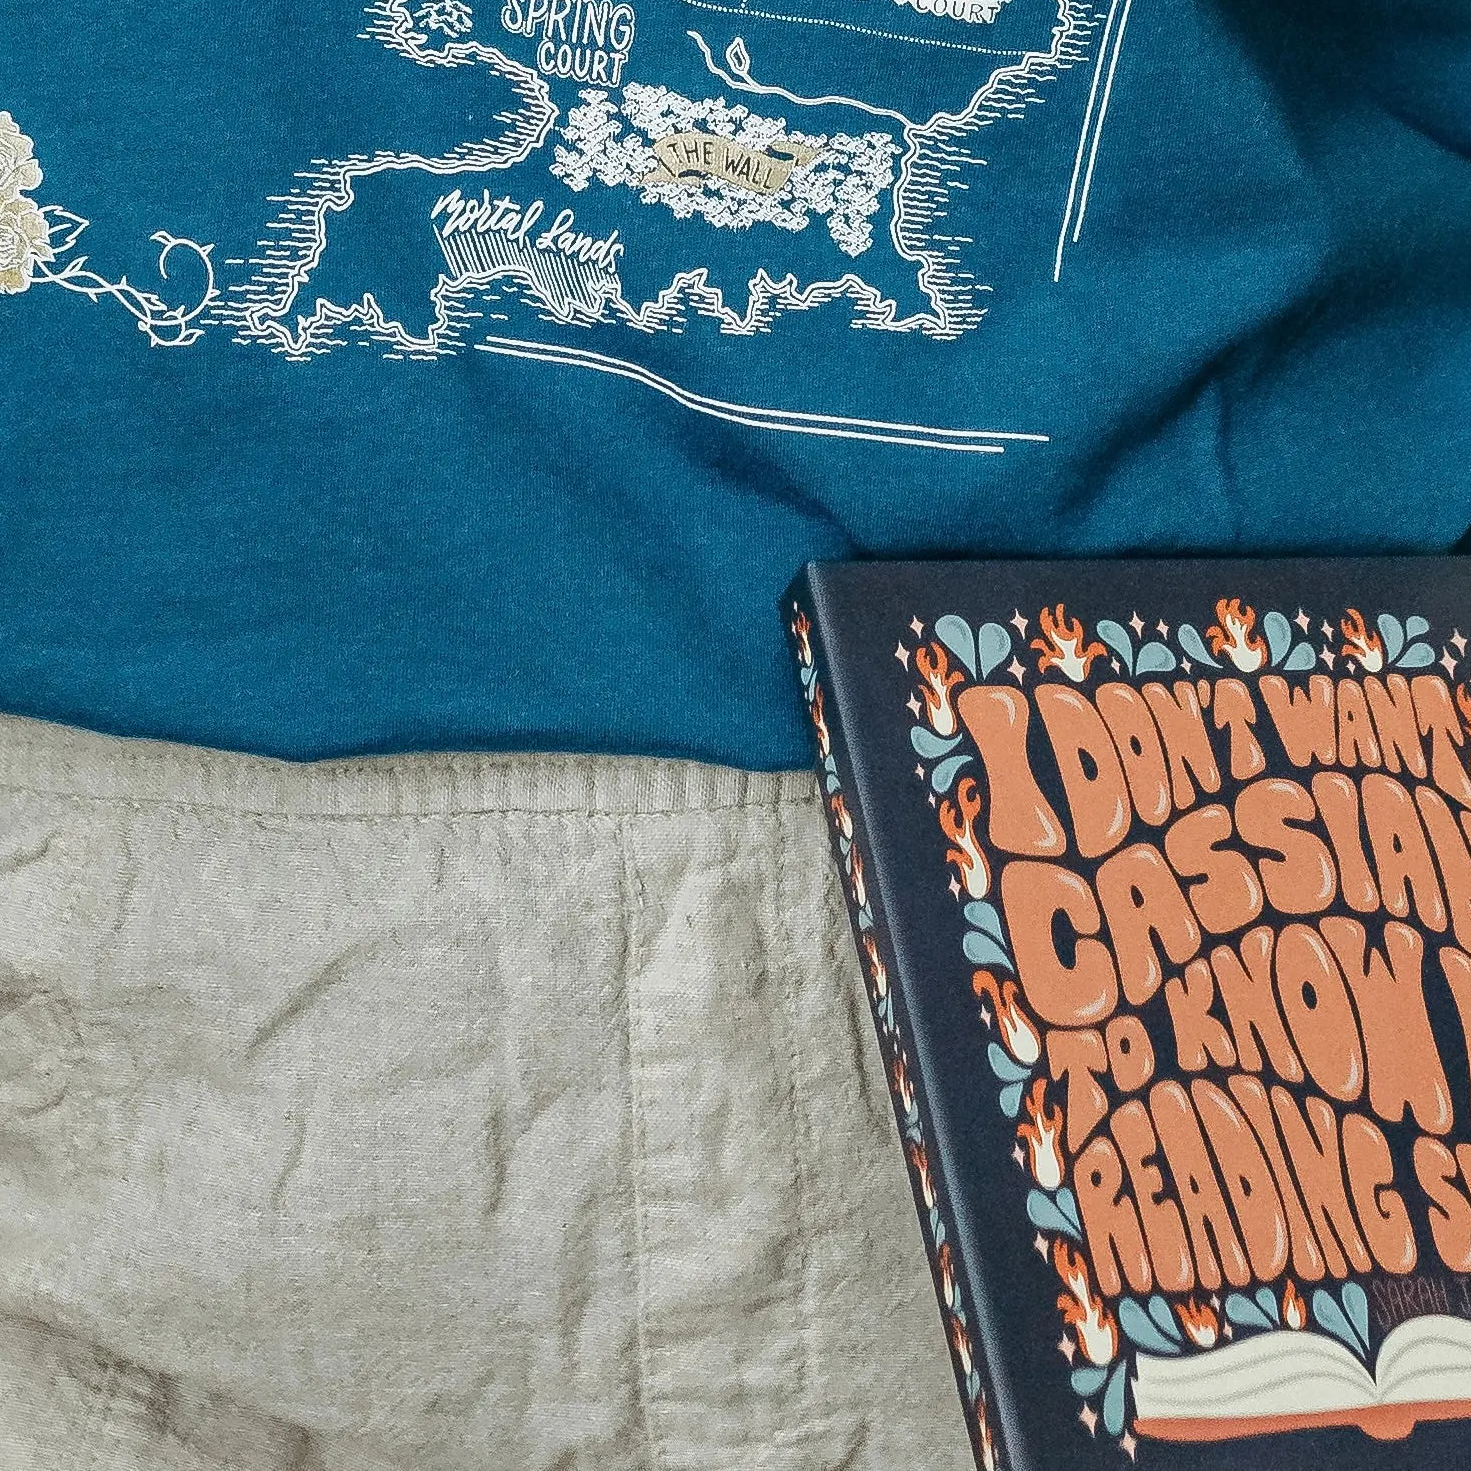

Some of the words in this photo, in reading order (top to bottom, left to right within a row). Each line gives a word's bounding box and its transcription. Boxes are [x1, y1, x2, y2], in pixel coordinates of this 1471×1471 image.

[537, 40, 628, 87] COURT
[666, 141, 714, 165] THE
[724, 147, 775, 190] WALL
[430, 188, 544, 249] Mortal
[536, 208, 624, 273] Lands
[957, 685, 1070, 857] I
[1035, 681, 1264, 858] DON'T
[1044, 1014, 1156, 1154] TO
[1165, 916, 1454, 1141] KNOW
[1073, 1077, 1419, 1298] READING
[1372, 1275, 1450, 1333] SARAH
